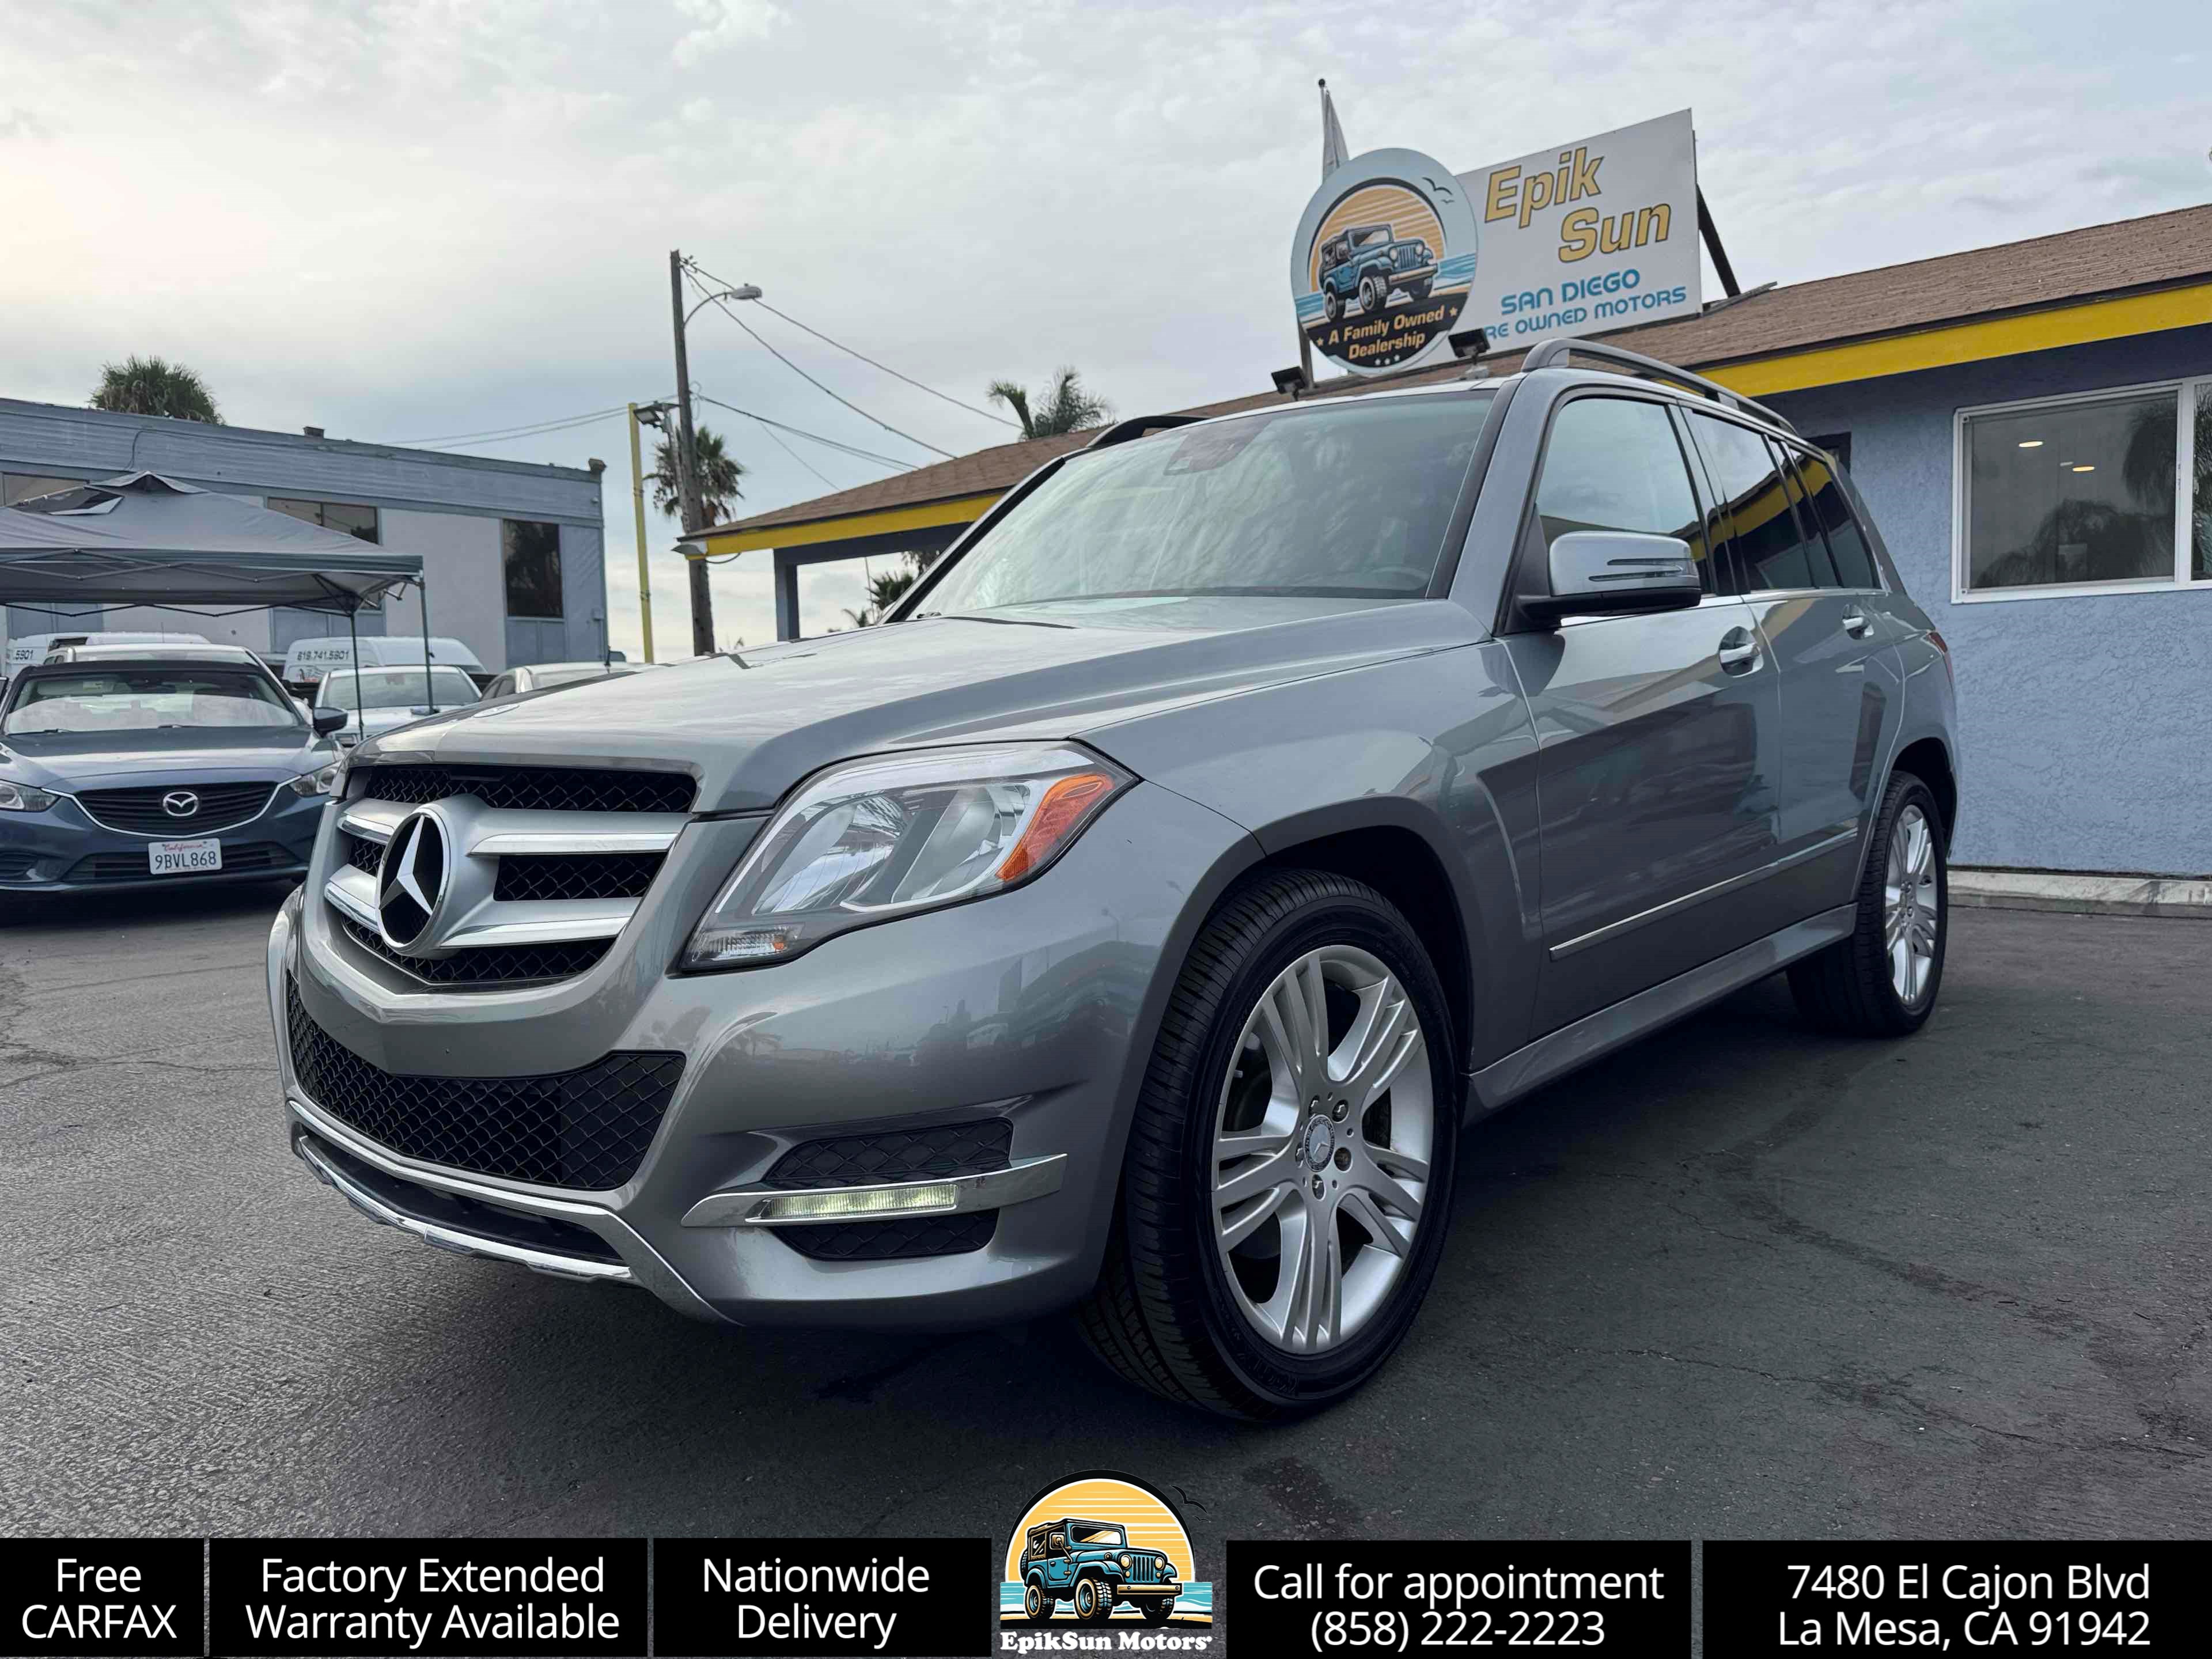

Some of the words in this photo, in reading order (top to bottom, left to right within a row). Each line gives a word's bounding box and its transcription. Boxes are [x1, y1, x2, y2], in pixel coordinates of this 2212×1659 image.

[1484, 146, 1604, 229] Epik
[1558, 203, 1672, 263] Sun
[1483, 323, 1509, 340] RE
[1515, 307, 1587, 334] OWNED
[1594, 286, 1687, 319] MOTORS
[1501, 287, 1554, 315] SAN
[1562, 268, 1641, 302] DIEGO
[1328, 329, 1339, 345] A
[1343, 320, 1389, 342] Family
[1393, 305, 1445, 330] Owned
[1349, 332, 1426, 359] Dealership
[155, 851, 217, 870] 9BVL868
